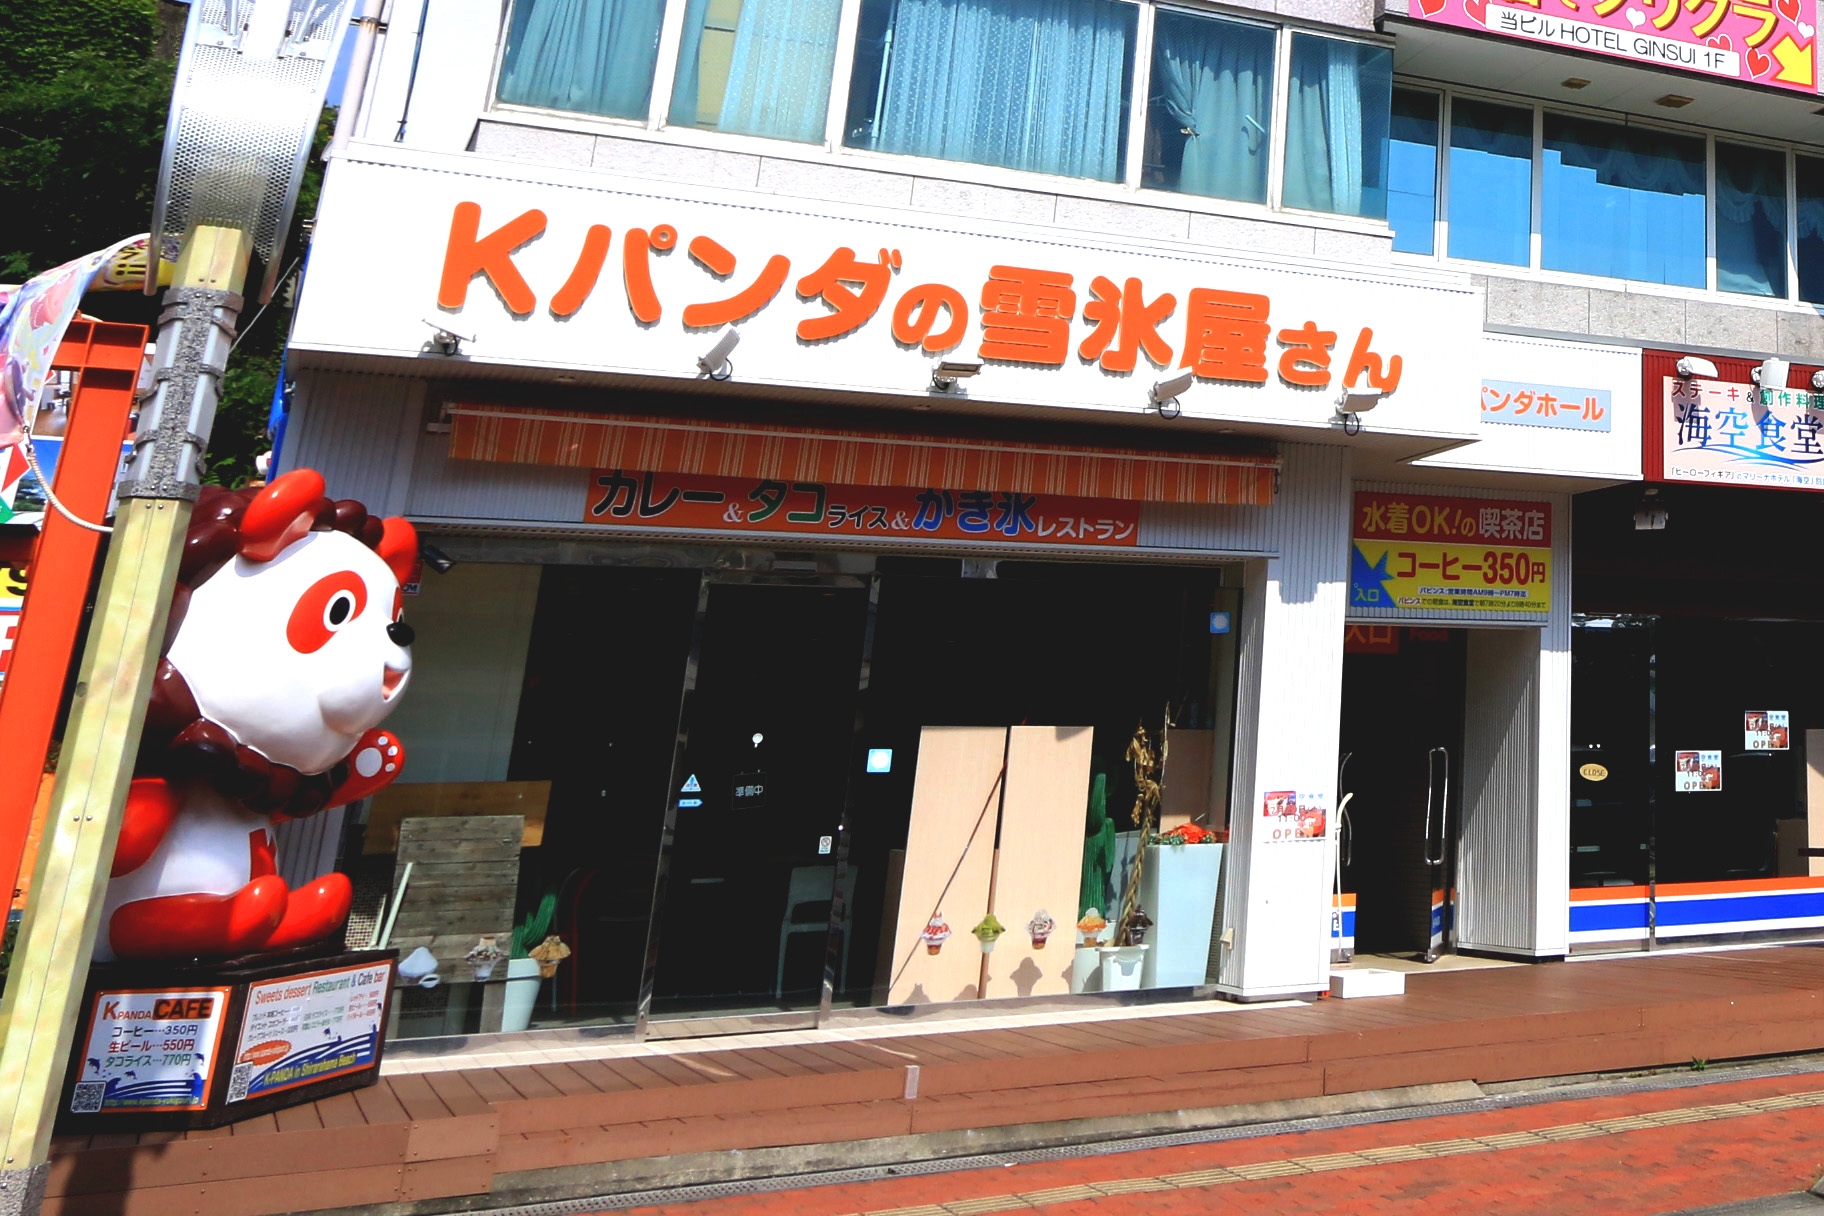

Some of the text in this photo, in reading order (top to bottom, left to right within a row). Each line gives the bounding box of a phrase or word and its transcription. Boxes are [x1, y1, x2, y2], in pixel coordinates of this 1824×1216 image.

[1500, 10, 1726, 69] 当ビル HOTEL GINSUI 1F
[437, 201, 1402, 393] Kパンダの雪氷屋さん
[1676, 403, 1824, 455] 海空食堂
[1362, 500, 1545, 541] 水着OK!の喫茶店
[1397, 550, 1546, 586] コーヒー350円
[1354, 589, 1380, 602] 入口
[1583, 769, 1607, 777] CLOSE
[735, 785, 763, 797] 準備中
[255, 990, 283, 1005] Sweets
[283, 983, 313, 1000] dessert
[358, 973, 373, 985] Cafe
[373, 971, 385, 983] bar
[153, 998, 215, 1019] CAFE
